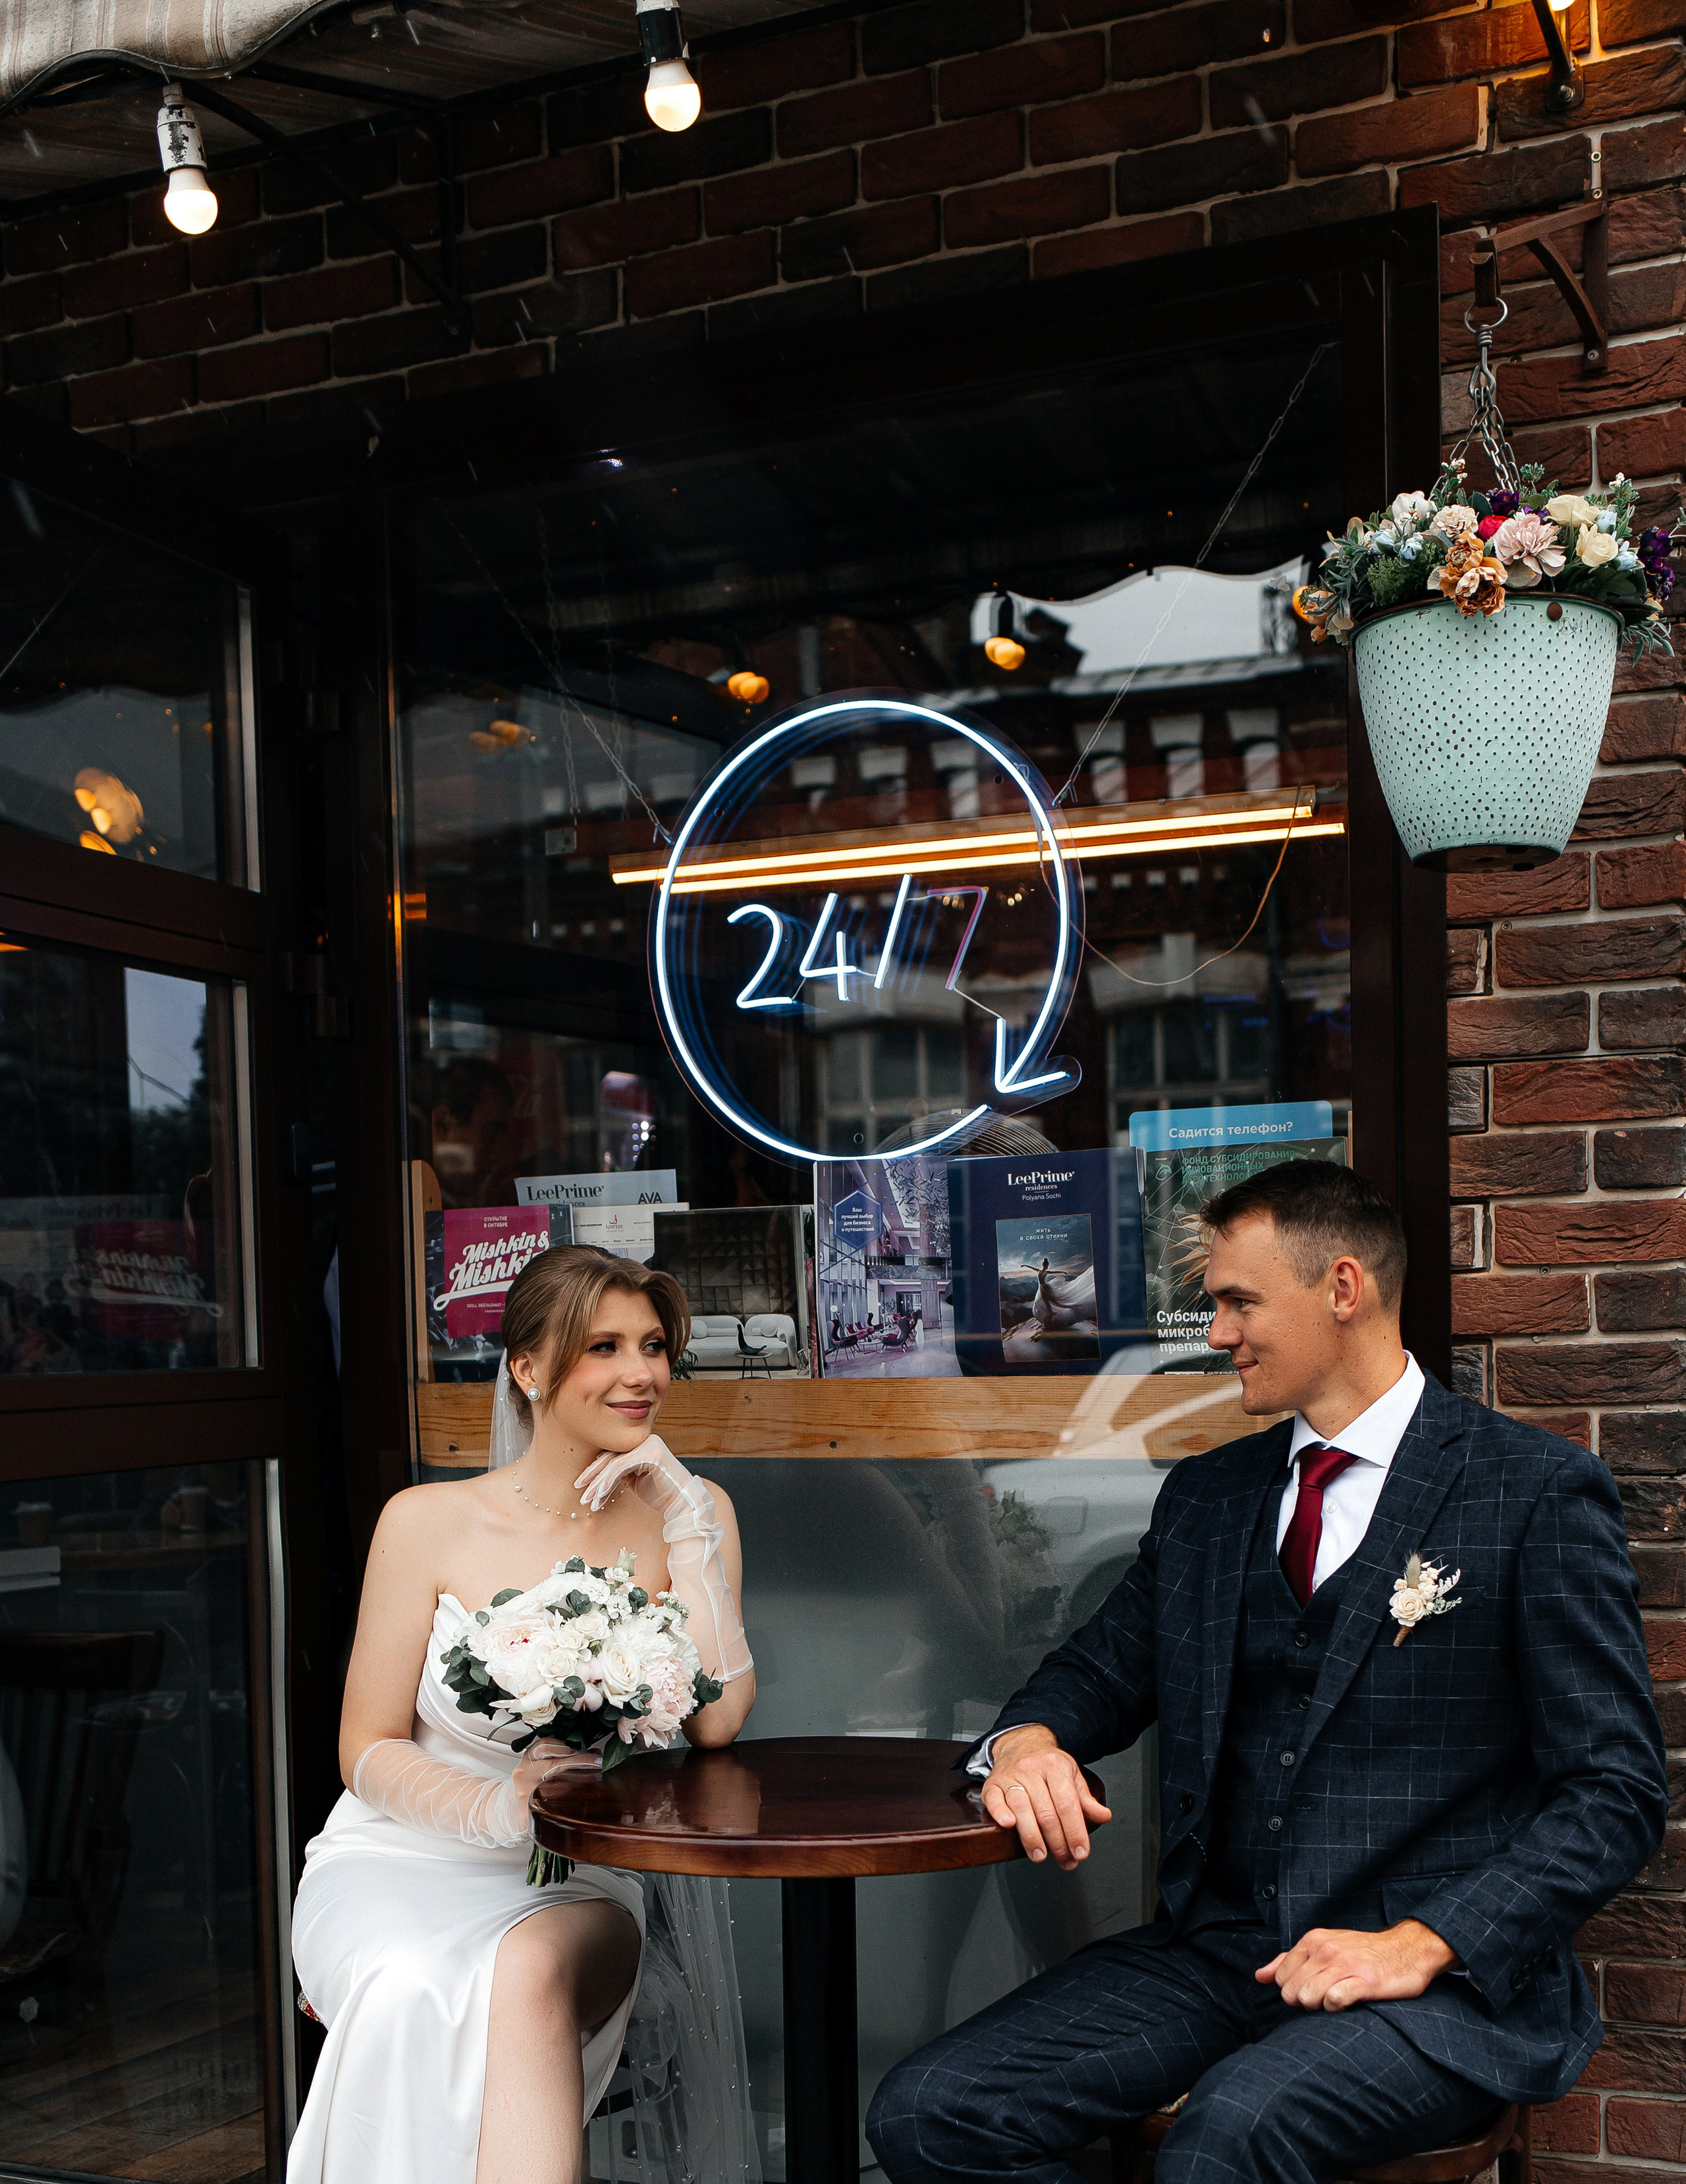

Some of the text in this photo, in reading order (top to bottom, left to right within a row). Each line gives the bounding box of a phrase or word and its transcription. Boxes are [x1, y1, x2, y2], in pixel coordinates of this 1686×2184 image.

[727, 873, 989, 1008] 24/7
[1168, 1121, 1293, 1139] Садится телефон?
[1182, 1150, 1295, 1165] ФОНД СУБСИДИРОВАНИЯ
[1182, 1162, 1264, 1174] ИННОВАЦИОННЫХ
[1008, 1170, 1075, 1186] LeePrime
[638, 1192, 663, 1204] AVA
[463, 1230, 550, 1267] Mishkin &
